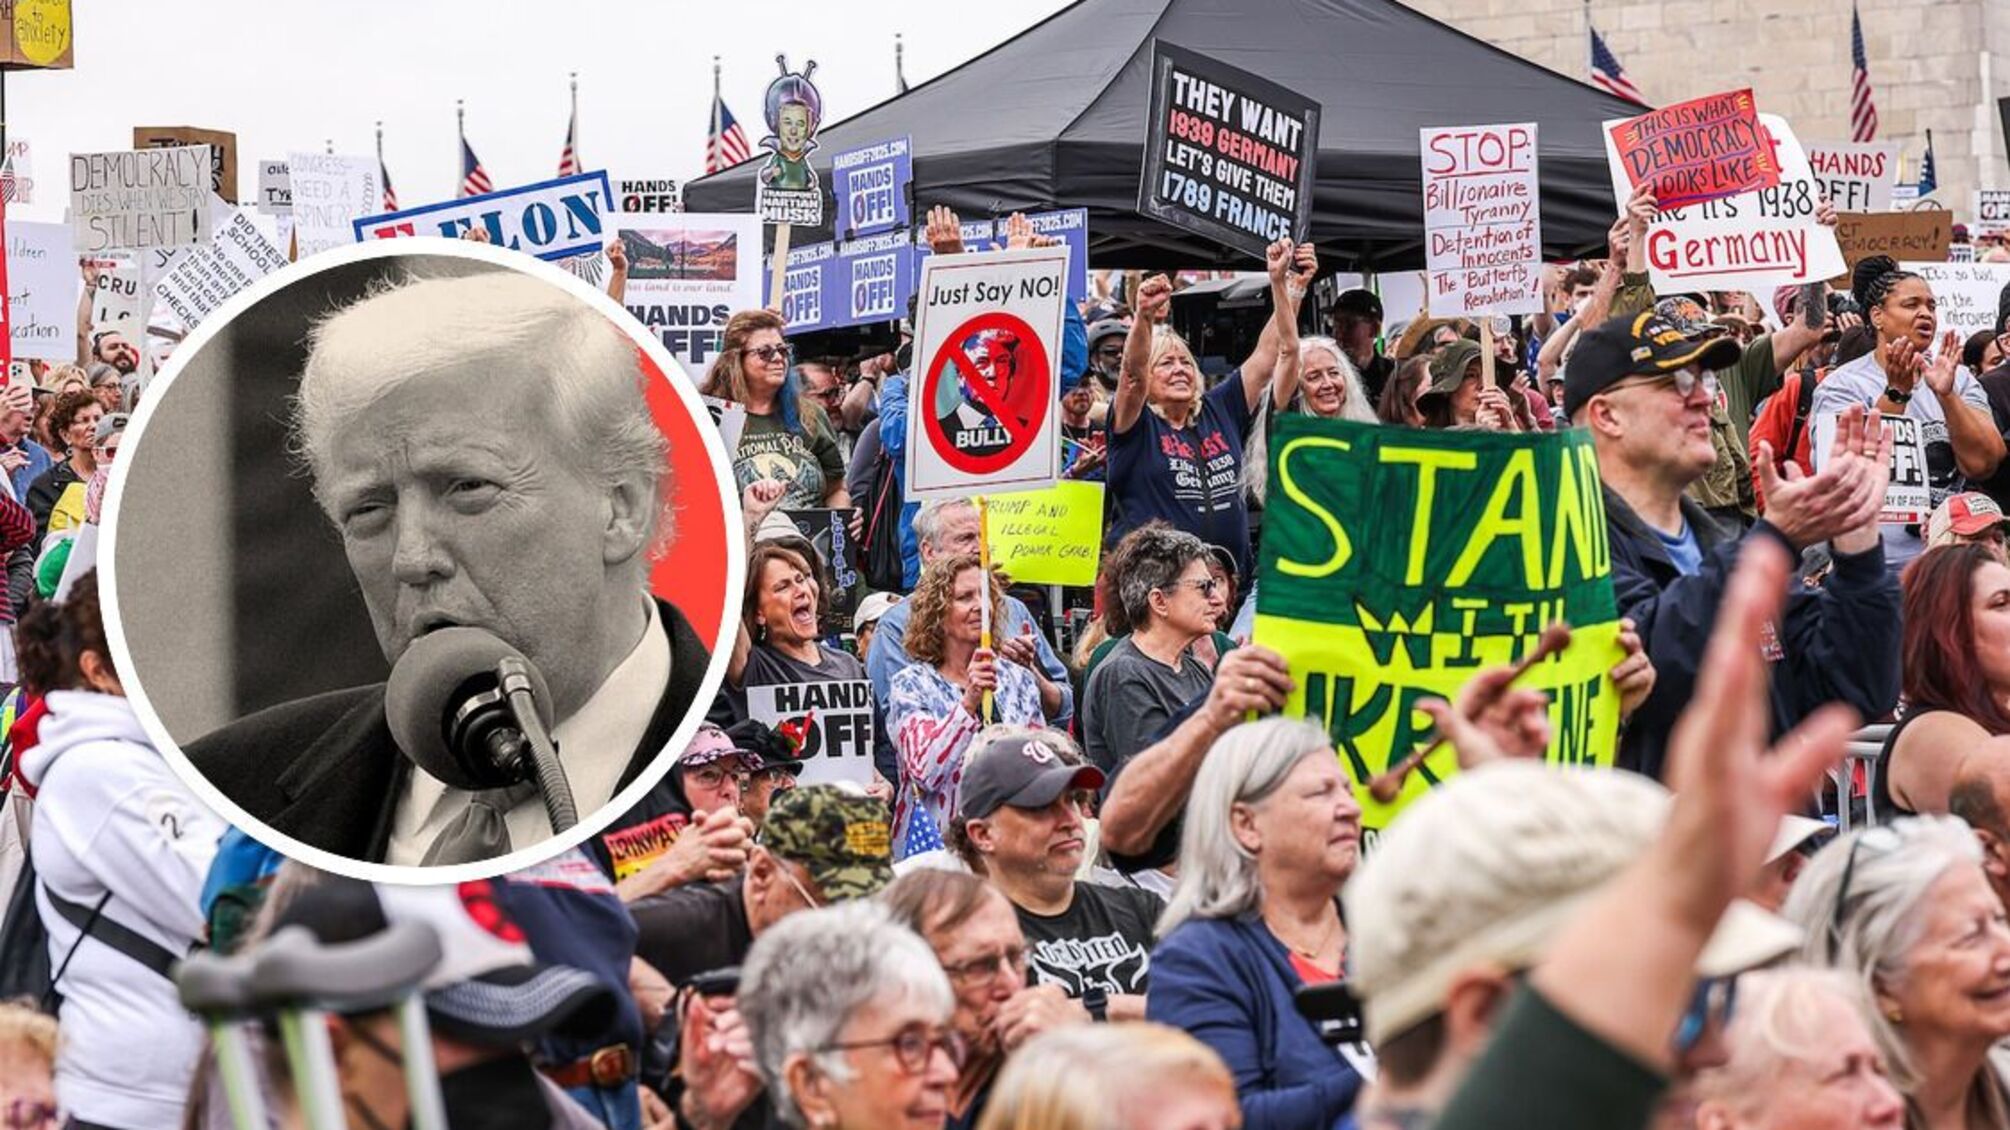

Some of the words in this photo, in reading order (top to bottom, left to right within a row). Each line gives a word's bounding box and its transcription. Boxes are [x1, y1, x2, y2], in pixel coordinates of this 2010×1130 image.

[16, 18, 66, 50] anxiety
[1173, 71, 1236, 123] THEY
[1241, 97, 1302, 151] WANT
[1633, 109, 1673, 141] THIS
[1675, 109, 1690, 125] IS
[1692, 95, 1739, 123] WHAT
[1169, 109, 1214, 148] 1939
[1217, 128, 1298, 182] GERMANY
[1427, 129, 1531, 174] STOP:
[1626, 114, 1761, 179] DEMOCRACY
[1811, 149, 1887, 178] HANDS
[72, 149, 208, 192] DEMOCRACY
[622, 180, 677, 194] HANDS
[851, 167, 892, 193] HANDS
[1166, 139, 1213, 176] LET'S
[1216, 158, 1252, 193] GIVE
[1255, 175, 1296, 212] THEM
[1652, 168, 1707, 197] LOOKS
[1710, 157, 1758, 189] LIKE
[81, 193, 113, 215] DIES
[117, 188, 155, 211] WHEN
[179, 186, 210, 208] STAY
[853, 188, 893, 225] OFF!
[1162, 170, 1212, 213] 1789
[1215, 189, 1292, 241] FRANCE
[1426, 179, 1528, 212] Billionaire
[1757, 178, 1814, 219] 1938
[762, 206, 820, 223] MUSK
[1459, 201, 1532, 232] Tyranny
[226, 226, 271, 276] SCHOOL
[233, 213, 256, 236] DID
[253, 232, 290, 270] THESE
[1432, 227, 1513, 256] Detention
[1516, 220, 1535, 240] of
[1462, 243, 1533, 268] Innocents
[1648, 228, 1807, 278] Germany
[178, 261, 201, 291] Each
[187, 254, 212, 281] than
[210, 280, 233, 300] any
[209, 260, 235, 289] more
[212, 242, 226, 261] No
[225, 261, 246, 280] one
[854, 258, 894, 281] HANDS
[1955, 270, 1969, 281] so
[170, 271, 192, 295] and
[188, 291, 211, 316] that
[854, 278, 894, 313] OFF!
[929, 282, 969, 306] Just
[975, 281, 1014, 305] Say
[1020, 275, 1060, 299] NO!
[1434, 273, 1457, 295] The
[156, 283, 201, 330] CHECKS
[626, 304, 730, 326] HANDS
[783, 290, 819, 325] OFF!
[656, 329, 726, 365] FF!
[736, 440, 780, 460] ATIONAL
[1175, 469, 1237, 489] Gerany
[1036, 503, 1069, 519] AND
[1276, 436, 1611, 590] STAND
[1353, 596, 1565, 670] WITH
